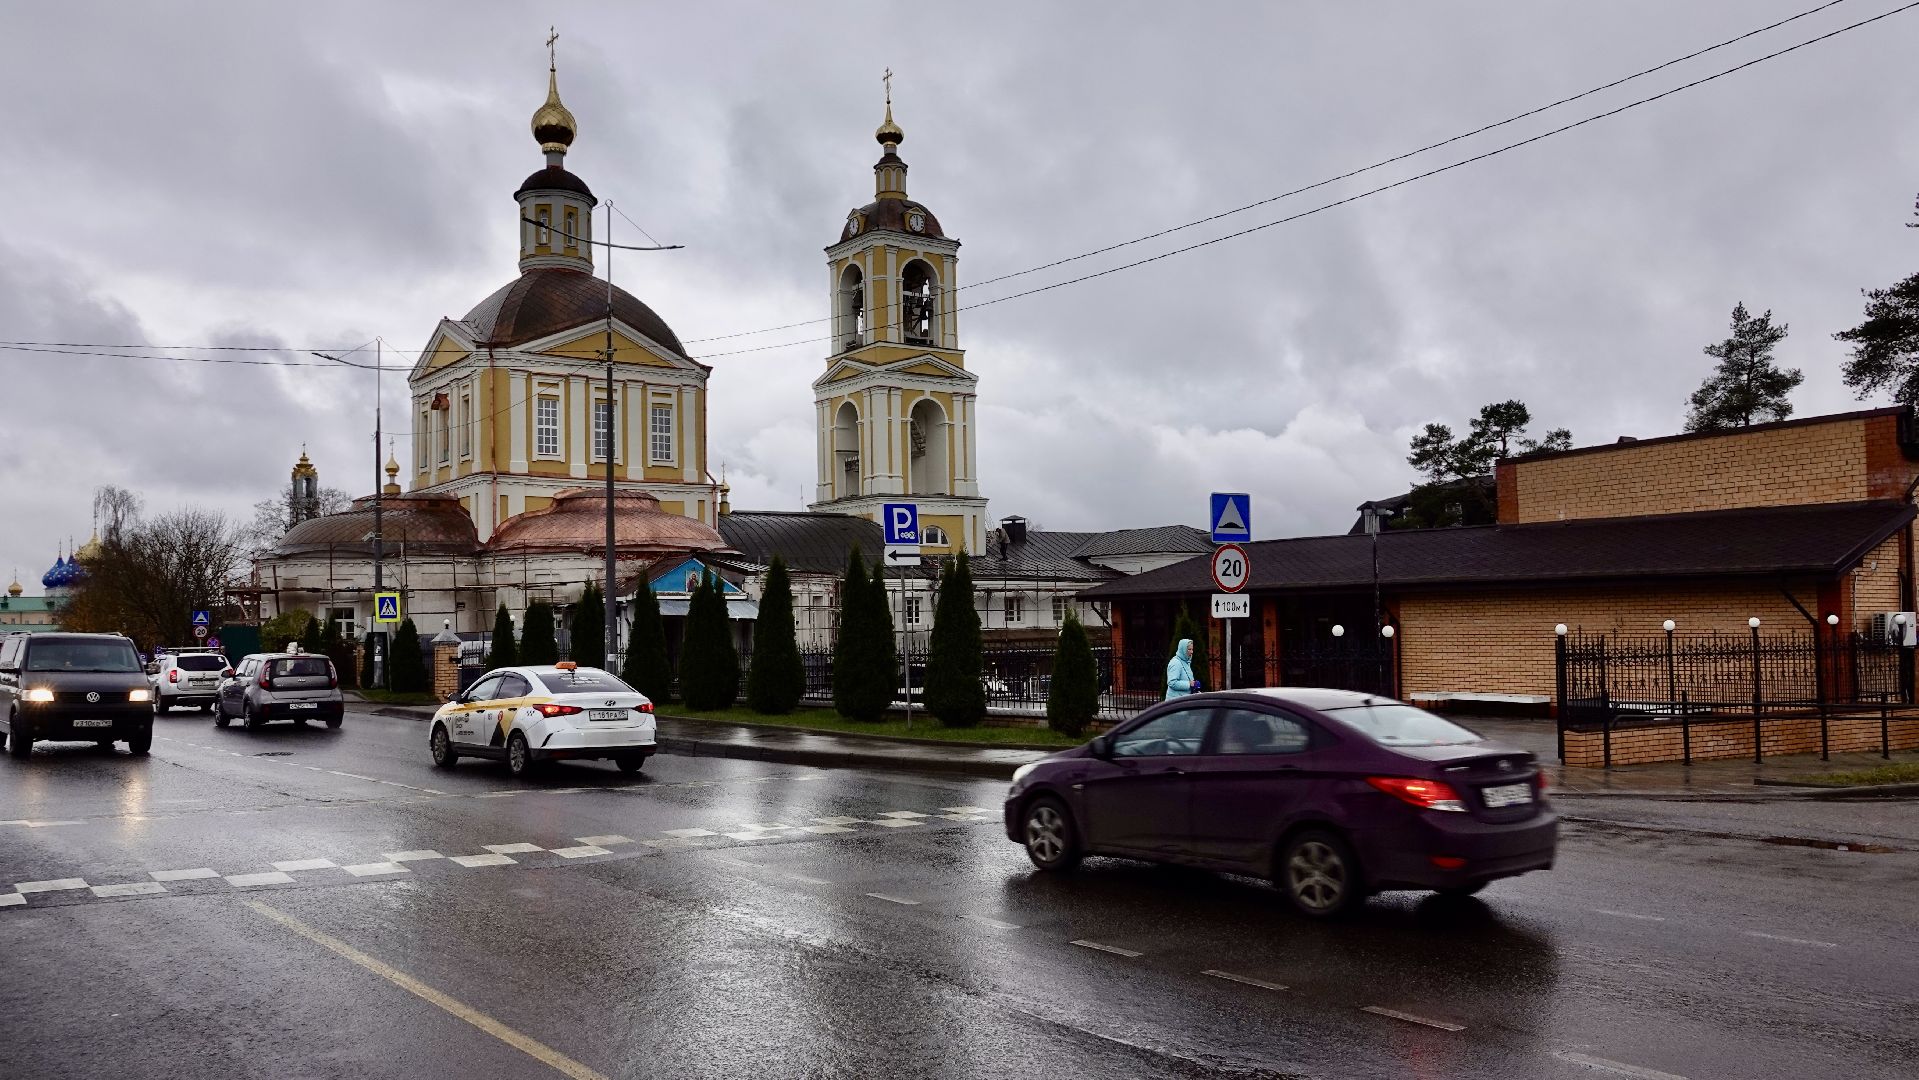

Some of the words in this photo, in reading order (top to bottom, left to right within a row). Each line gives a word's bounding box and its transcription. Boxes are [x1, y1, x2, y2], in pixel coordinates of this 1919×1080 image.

[893, 507, 912, 540] P
[1222, 558, 1242, 577] 20
[196, 628, 206, 636] 20
